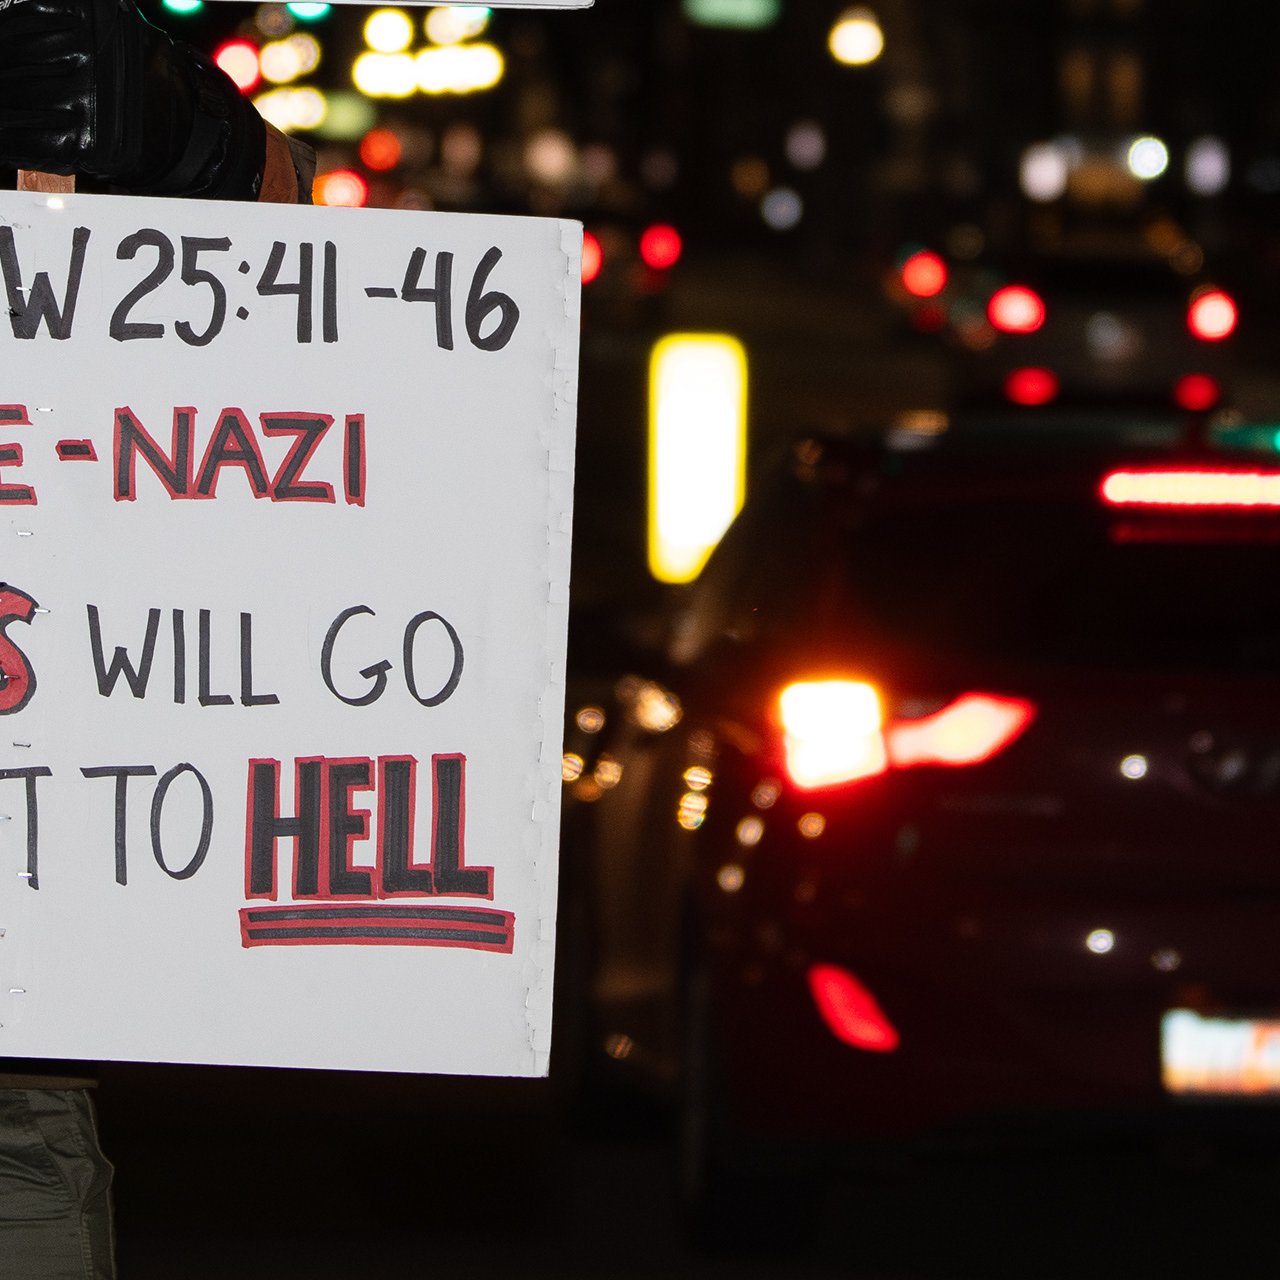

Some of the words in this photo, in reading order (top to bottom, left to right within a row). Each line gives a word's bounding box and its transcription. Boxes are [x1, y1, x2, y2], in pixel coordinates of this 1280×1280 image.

[87, 604, 280, 707] WILL
[321, 605, 464, 707] GO
[80, 763, 213, 886] TO
[245, 753, 494, 901] HELL
